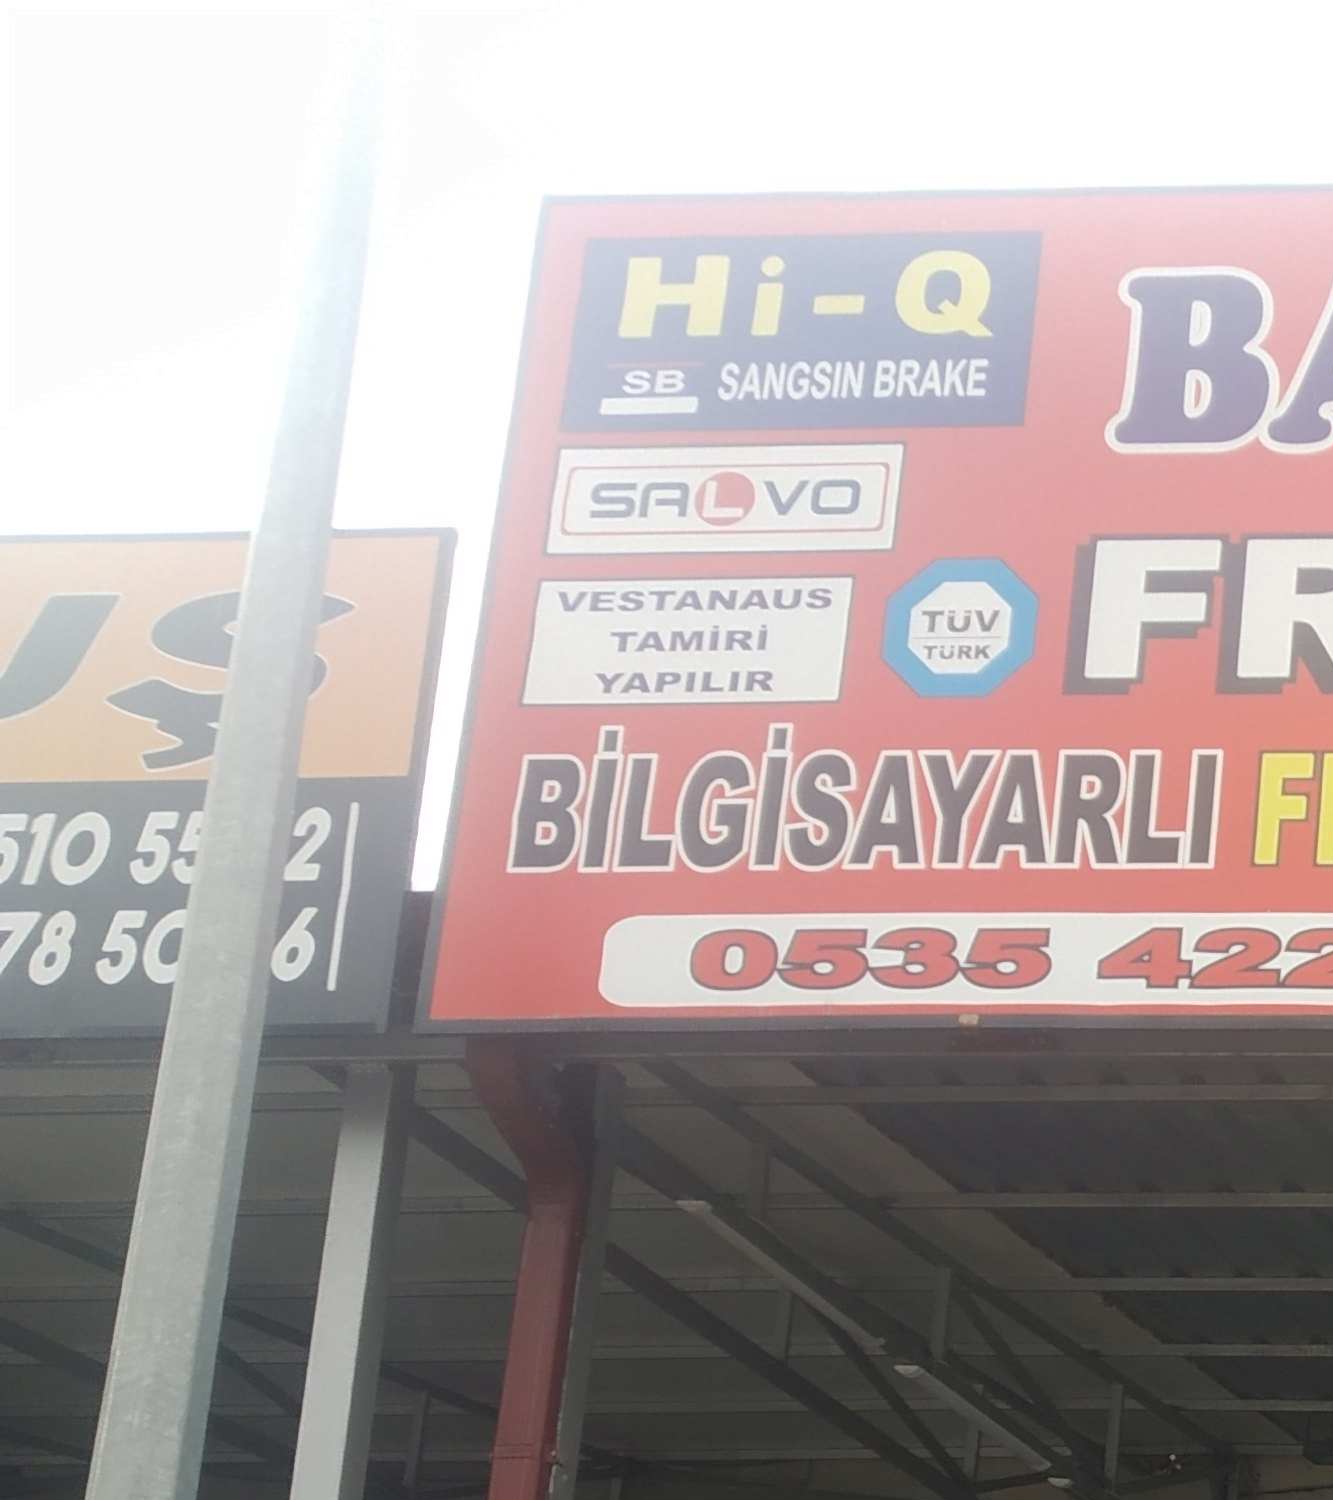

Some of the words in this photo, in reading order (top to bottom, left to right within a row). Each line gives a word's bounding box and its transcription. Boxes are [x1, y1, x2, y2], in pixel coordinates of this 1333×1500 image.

[621, 368, 687, 394] SB
[717, 361, 864, 400] SANGSIN
[872, 358, 989, 398] BRAKE
[588, 470, 861, 528] SALVO
[557, 587, 833, 613] VESTANAUS
[922, 608, 1000, 634] TÜV
[610, 624, 768, 652] TAMİRİ
[923, 642, 992, 660] TÜRK
[595, 669, 774, 694] YAPILIR
[506, 723, 1224, 873] BİLGİSAYARLI
[689, 927, 1052, 991] 0535
